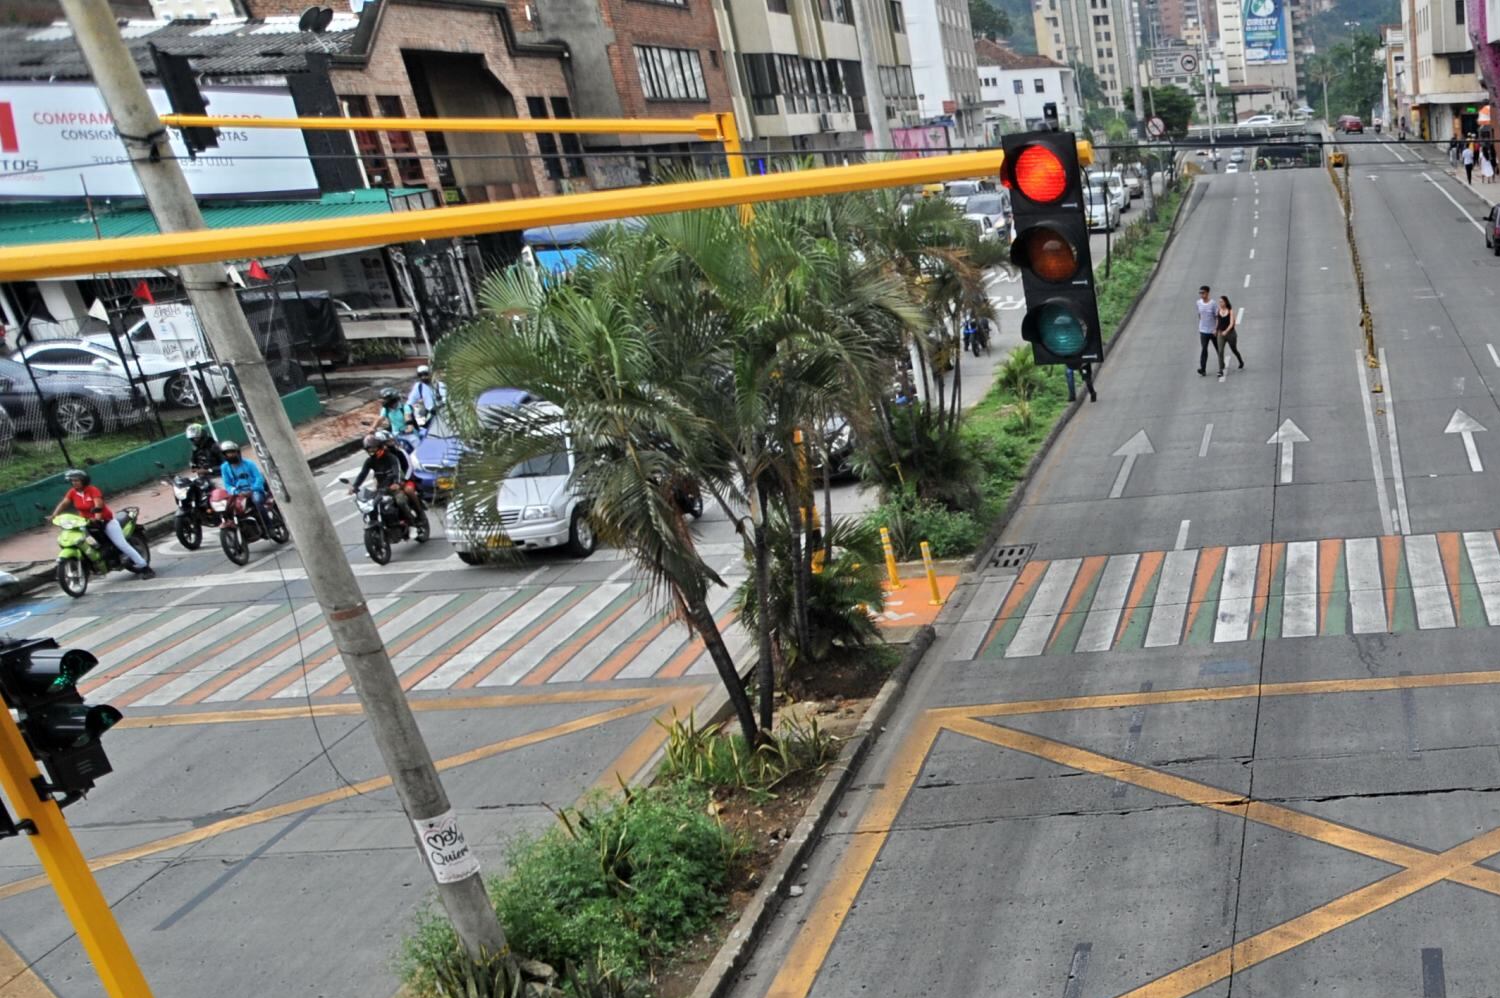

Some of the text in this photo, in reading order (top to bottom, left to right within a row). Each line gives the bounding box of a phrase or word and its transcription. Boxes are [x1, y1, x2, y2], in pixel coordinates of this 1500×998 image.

[33, 112, 114, 125] COMPRAM
[61, 129, 119, 141] CONSIGN
[0, 159, 39, 171] TOS
